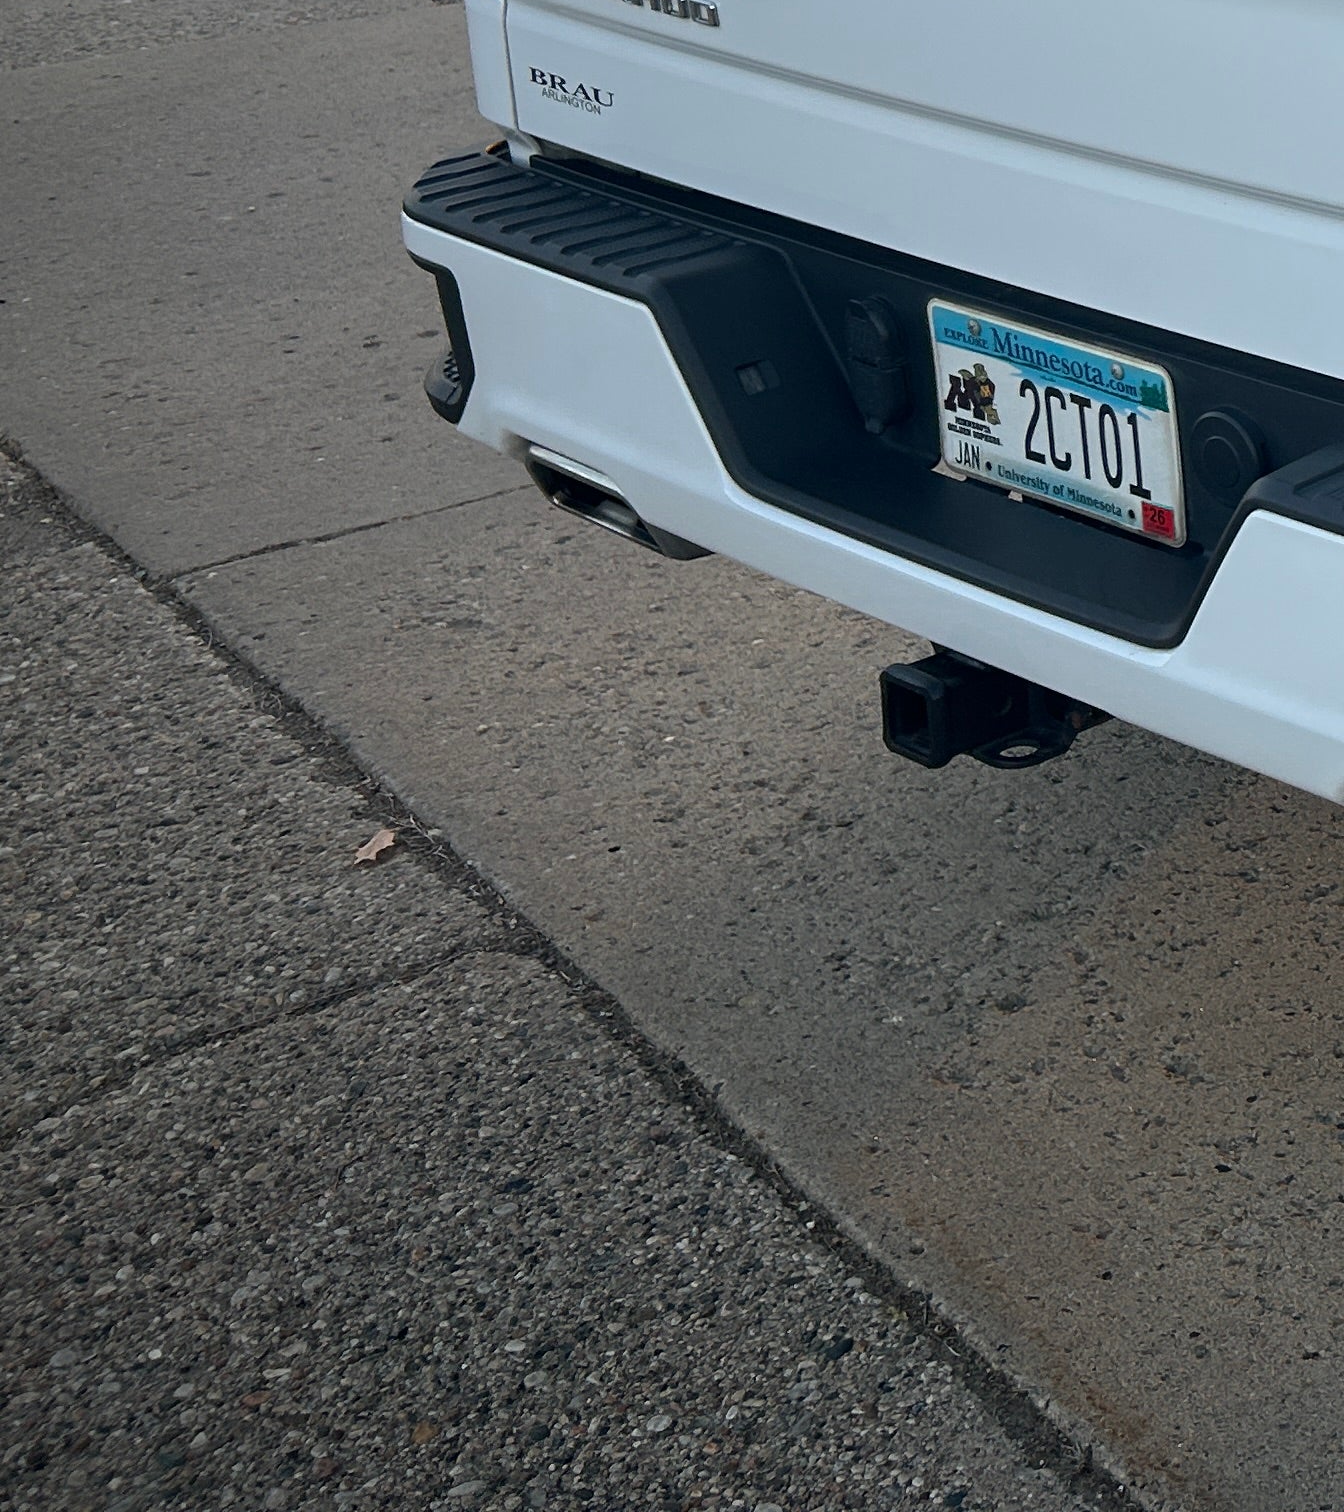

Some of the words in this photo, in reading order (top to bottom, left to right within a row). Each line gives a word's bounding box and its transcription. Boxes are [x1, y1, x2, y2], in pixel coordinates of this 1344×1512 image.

[528, 66, 614, 107] BRAU
[541, 88, 601, 115] ARLINGTON
[990, 327, 1137, 397] Minnesota.com
[1019, 379, 1152, 500] 2CT01
[955, 441, 981, 471] JAN
[997, 464, 1050, 494] University
[1053, 484, 1065, 497] of
[1067, 487, 1123, 517] Minnesota
[1149, 508, 1166, 525] 26
